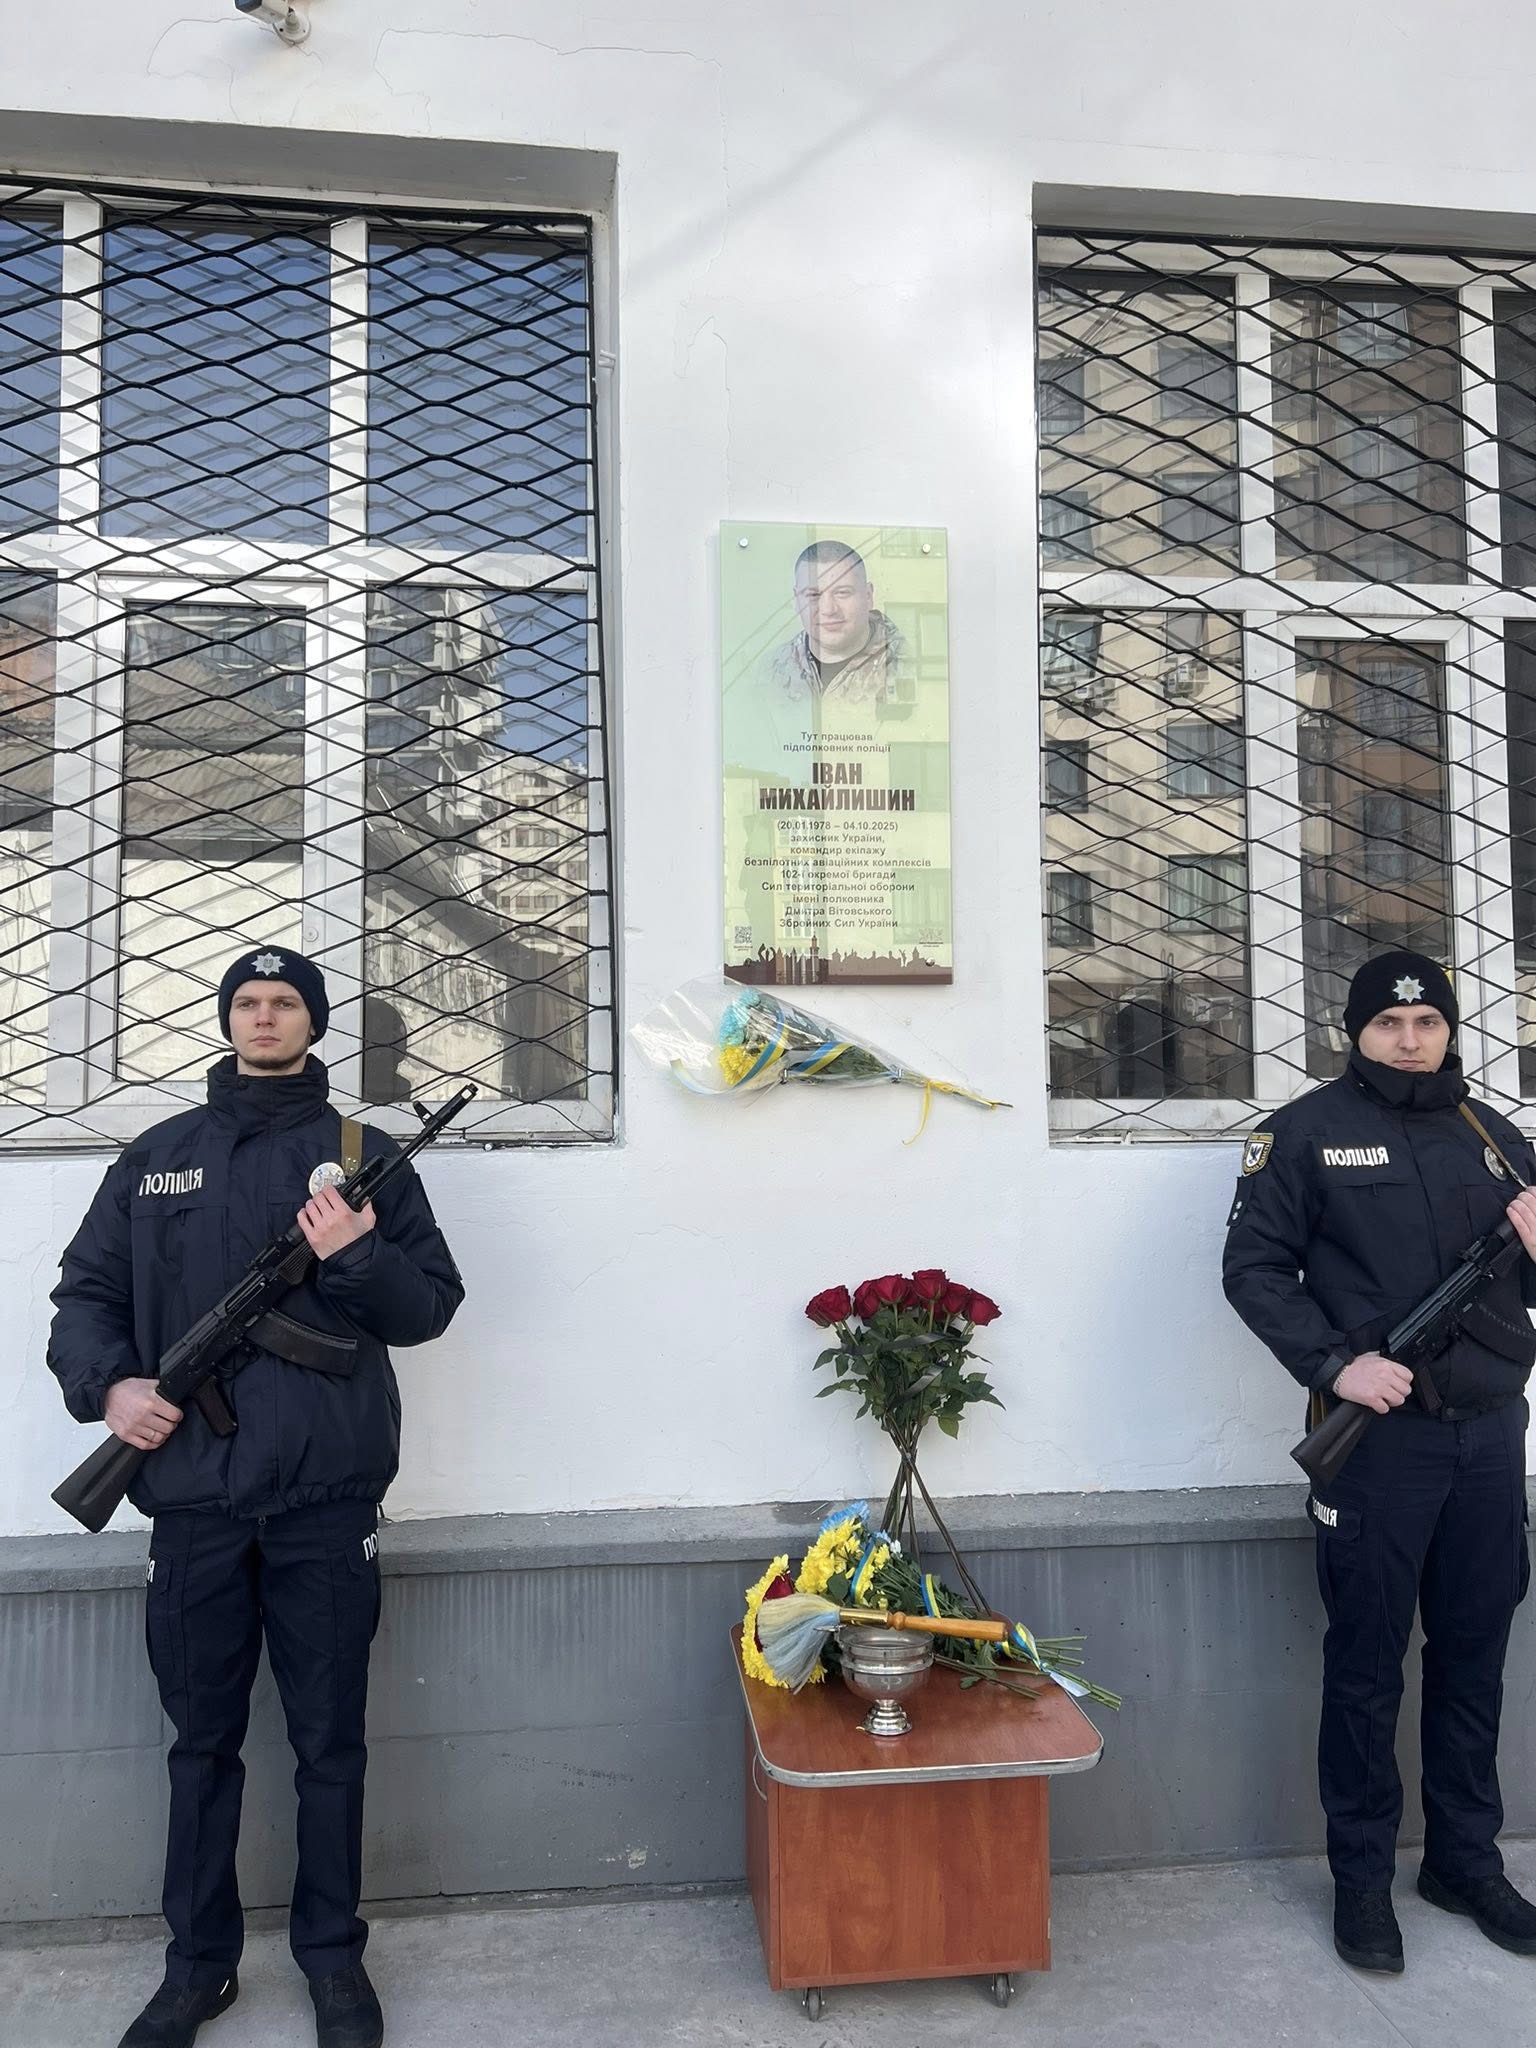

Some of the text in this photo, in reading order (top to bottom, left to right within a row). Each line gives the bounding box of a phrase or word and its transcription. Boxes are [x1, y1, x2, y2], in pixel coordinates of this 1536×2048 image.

[801, 731, 873, 743] Тут працював
[783, 743, 891, 753] підполковник поліції
[812, 762, 863, 785] ІВАН
[759, 784, 915, 811] МИХАЙЛИШИН
[777, 820, 831, 831] (20.01.1978
[843, 821, 898, 831] 04.10.2025)
[790, 834, 885, 844] захисник України,
[790, 847, 886, 857] командир екіпажу
[744, 857, 932, 868] безпілотних авіаційних комплексів
[808, 869, 850, 880] окремої
[852, 869, 896, 880] бригади
[761, 881, 915, 893] Сил територіальної оборони
[793, 894, 884, 904] імені полковника
[785, 906, 892, 918] Дмитра Вітовського
[779, 918, 898, 929] Збройних Сил України
[1323, 1146, 1389, 1166] ПОЛІЦІЯ
[139, 1167, 204, 1197] ПОЛІЦІЯ
